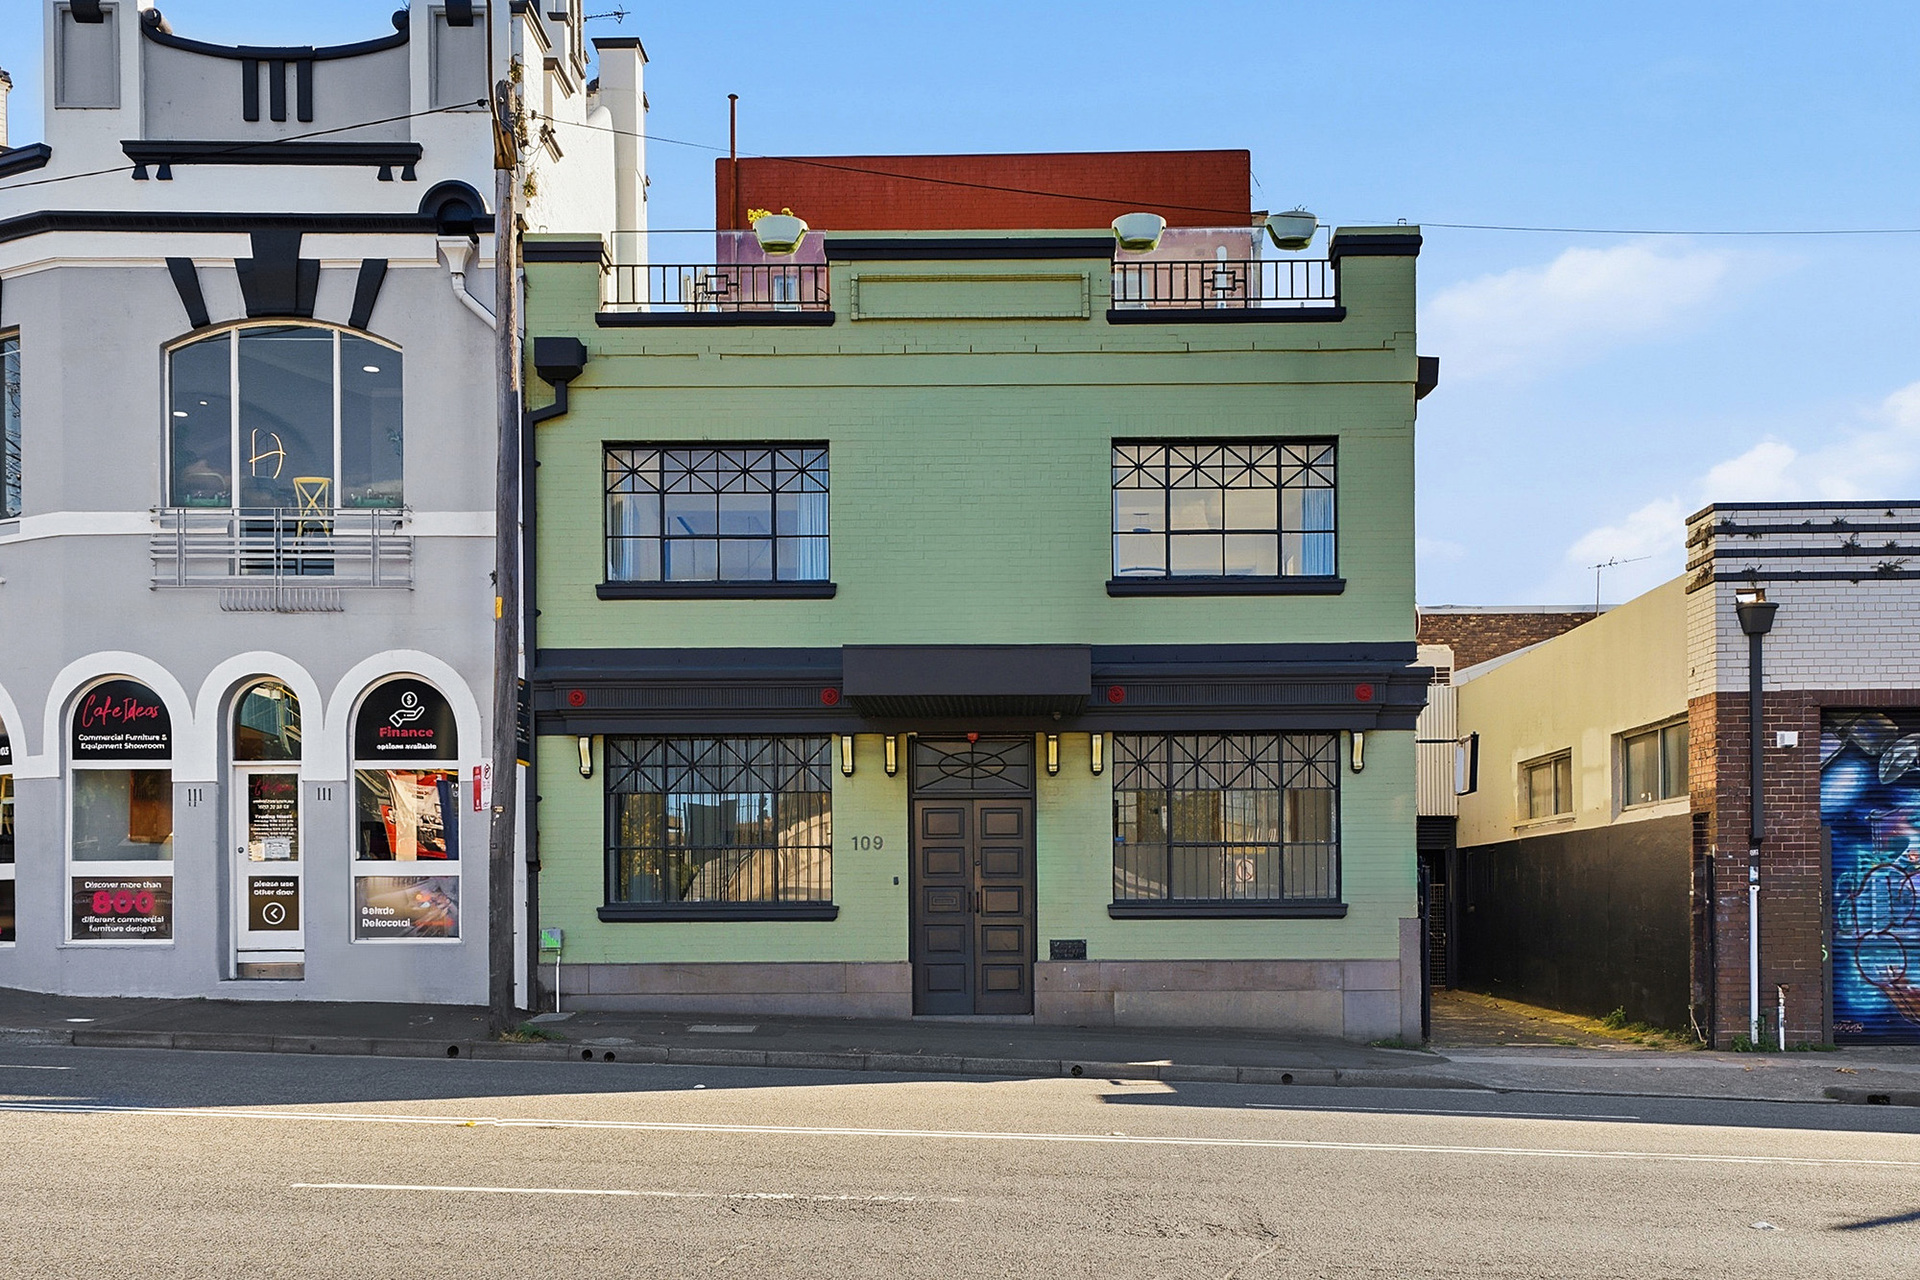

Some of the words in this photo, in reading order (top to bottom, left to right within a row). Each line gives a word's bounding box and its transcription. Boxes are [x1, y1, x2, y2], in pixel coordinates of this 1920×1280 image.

[82, 694, 122, 727] Cafe
[122, 698, 159, 724] Ideas
[379, 726, 434, 737] Finance
[80, 743, 123, 751] Equipment
[124, 742, 165, 750] Showroom
[851, 835, 884, 851] 109
[84, 881, 119, 889] Discover
[143, 881, 162, 889] than
[92, 890, 155, 914] 800
[89, 924, 124, 932] furniture
[125, 924, 157, 934] designs
